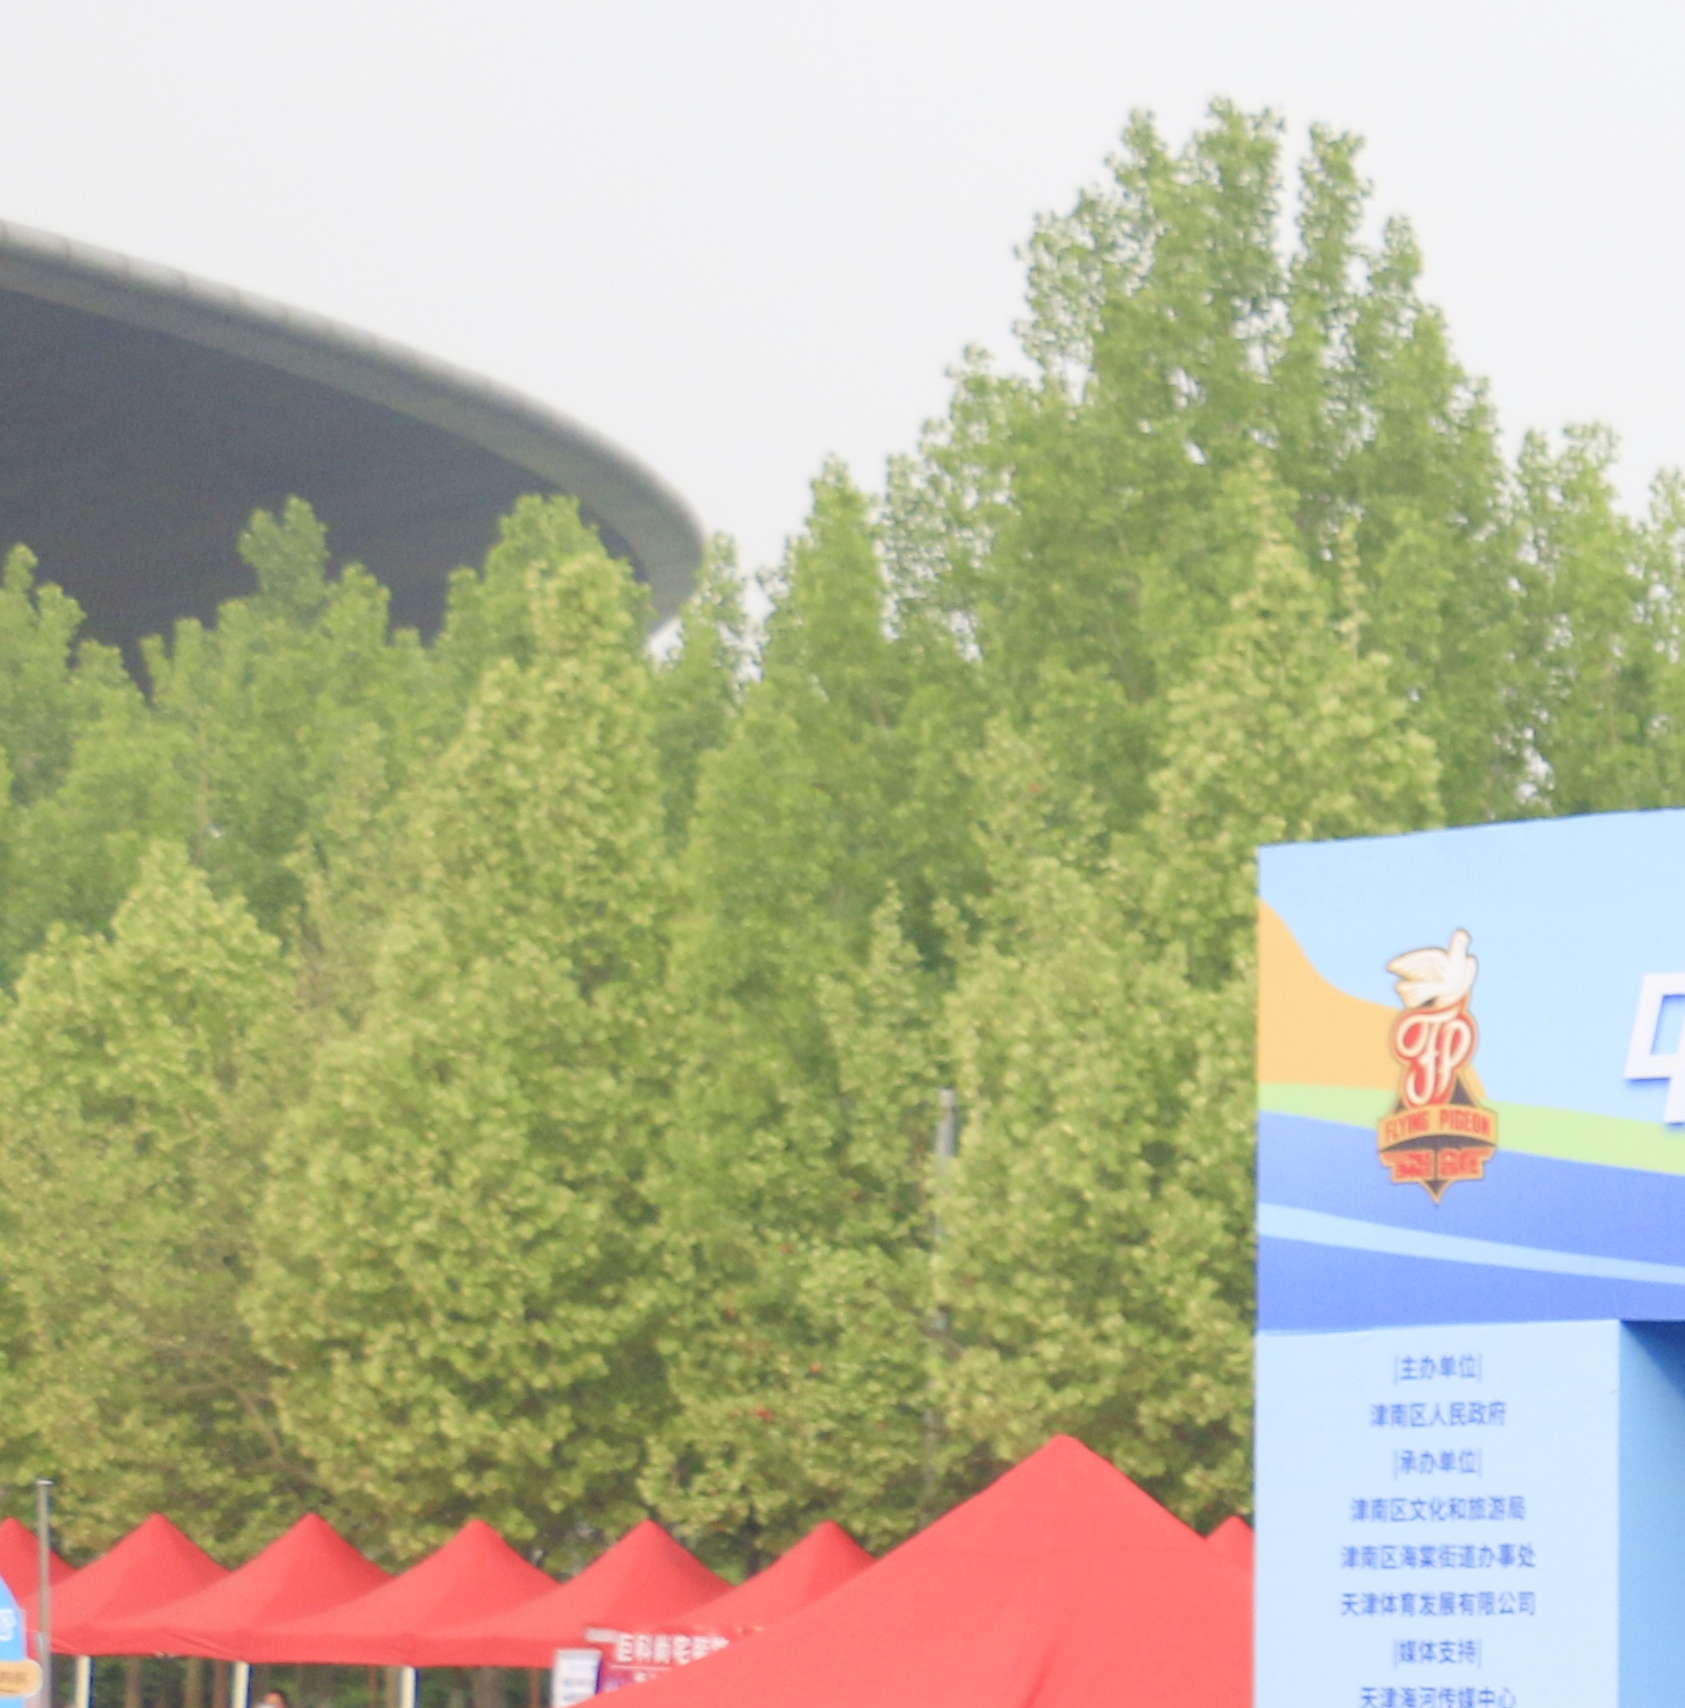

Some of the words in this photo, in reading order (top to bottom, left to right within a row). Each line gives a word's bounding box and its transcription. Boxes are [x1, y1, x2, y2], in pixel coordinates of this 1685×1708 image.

[1385, 1110, 1430, 1142] FLYING
[1439, 1109, 1491, 1138] PIGEON
[1370, 1402, 1507, 1428] 津南区人民政府
[1351, 1496, 1527, 1522] 津南区文化和旅游局
[1341, 1543, 1537, 1570] 津南区海棠街道办事处
[1341, 1592, 1536, 1617] 天津体育发展有限公司
